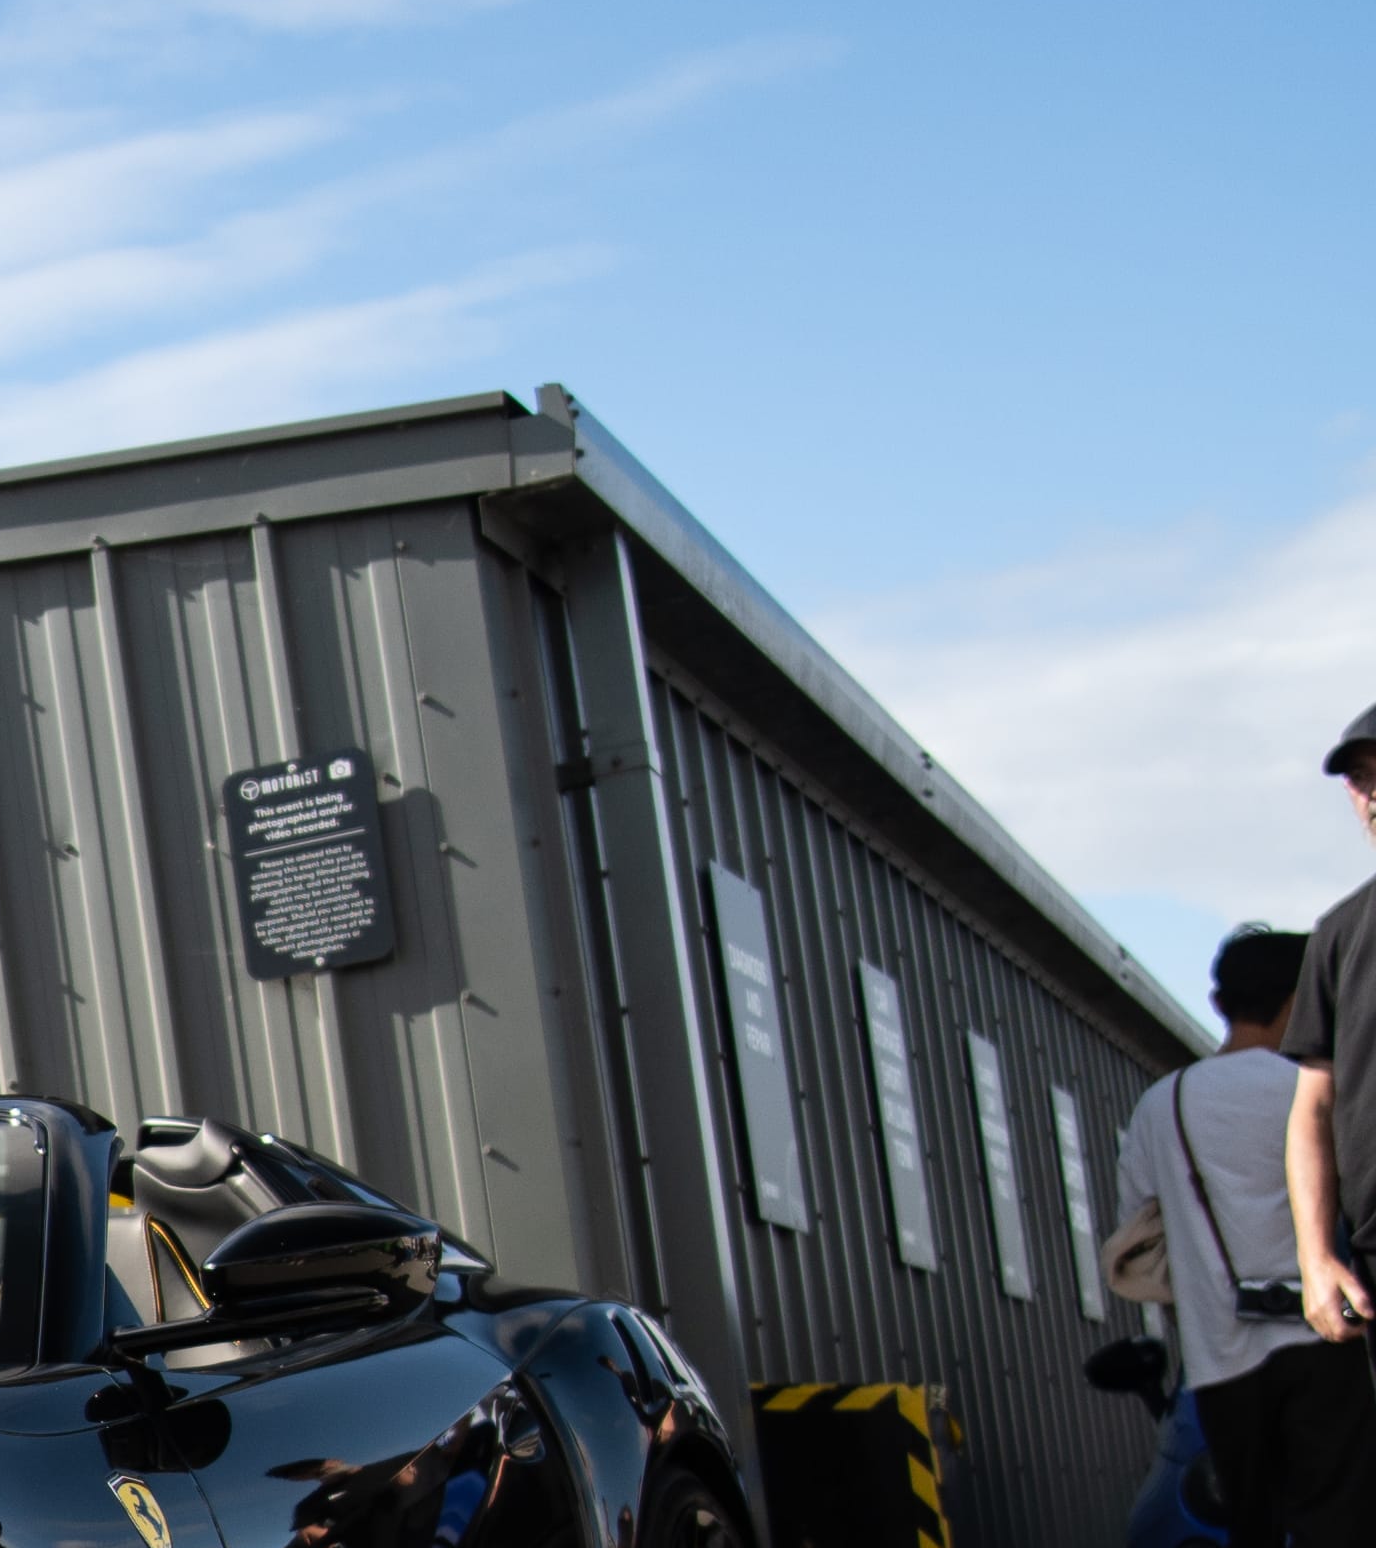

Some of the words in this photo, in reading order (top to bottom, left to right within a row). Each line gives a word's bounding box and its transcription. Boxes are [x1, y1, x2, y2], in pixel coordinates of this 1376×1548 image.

[262, 769, 319, 795] MOTORIST
[249, 811, 318, 833] photographed
[319, 803, 353, 816] and/or
[255, 807, 275, 818] This
[277, 802, 304, 813] event
[316, 792, 344, 807] being
[265, 828, 292, 841] video
